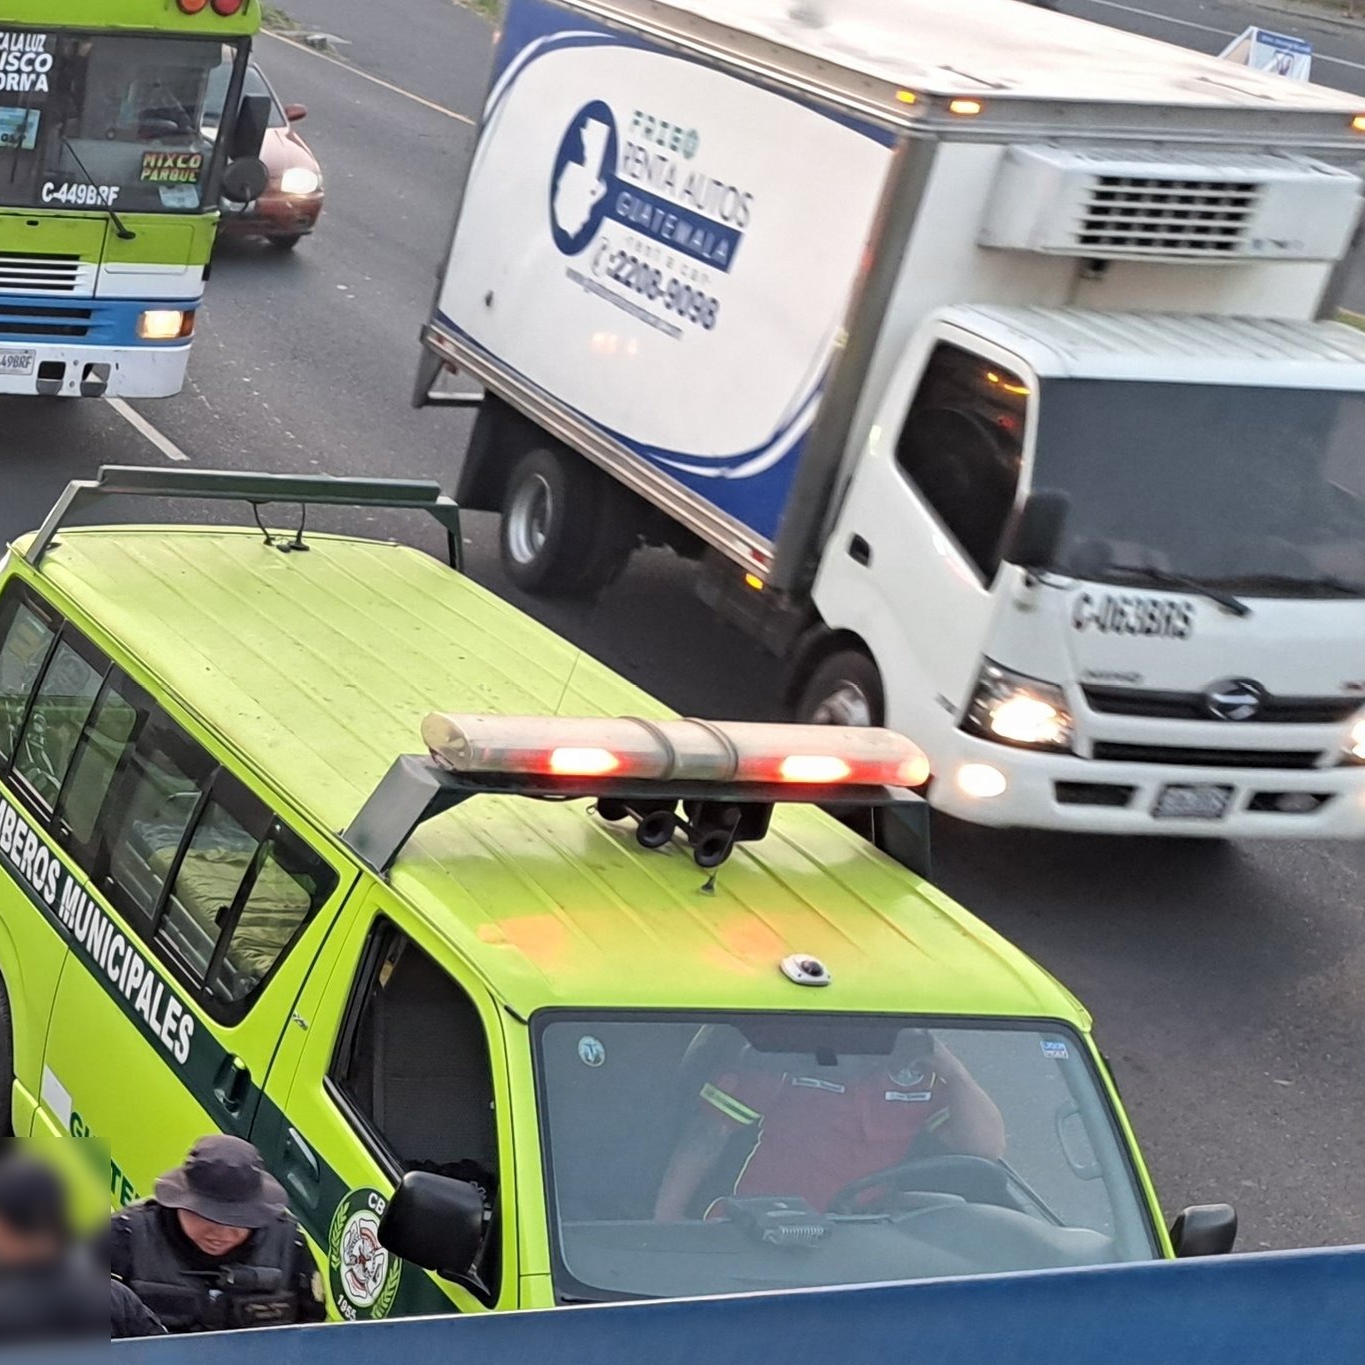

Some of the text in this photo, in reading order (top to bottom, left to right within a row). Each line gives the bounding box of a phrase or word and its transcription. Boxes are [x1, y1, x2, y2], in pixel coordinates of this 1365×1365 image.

[11, 32, 26, 51] LA
[25, 34, 47, 52] LUZ
[142, 152, 203, 169] MIXCO
[140, 168, 200, 183] PARQUE
[58, 875, 195, 1065] MUNICIPALES
[367, 1192, 386, 1216] CB
